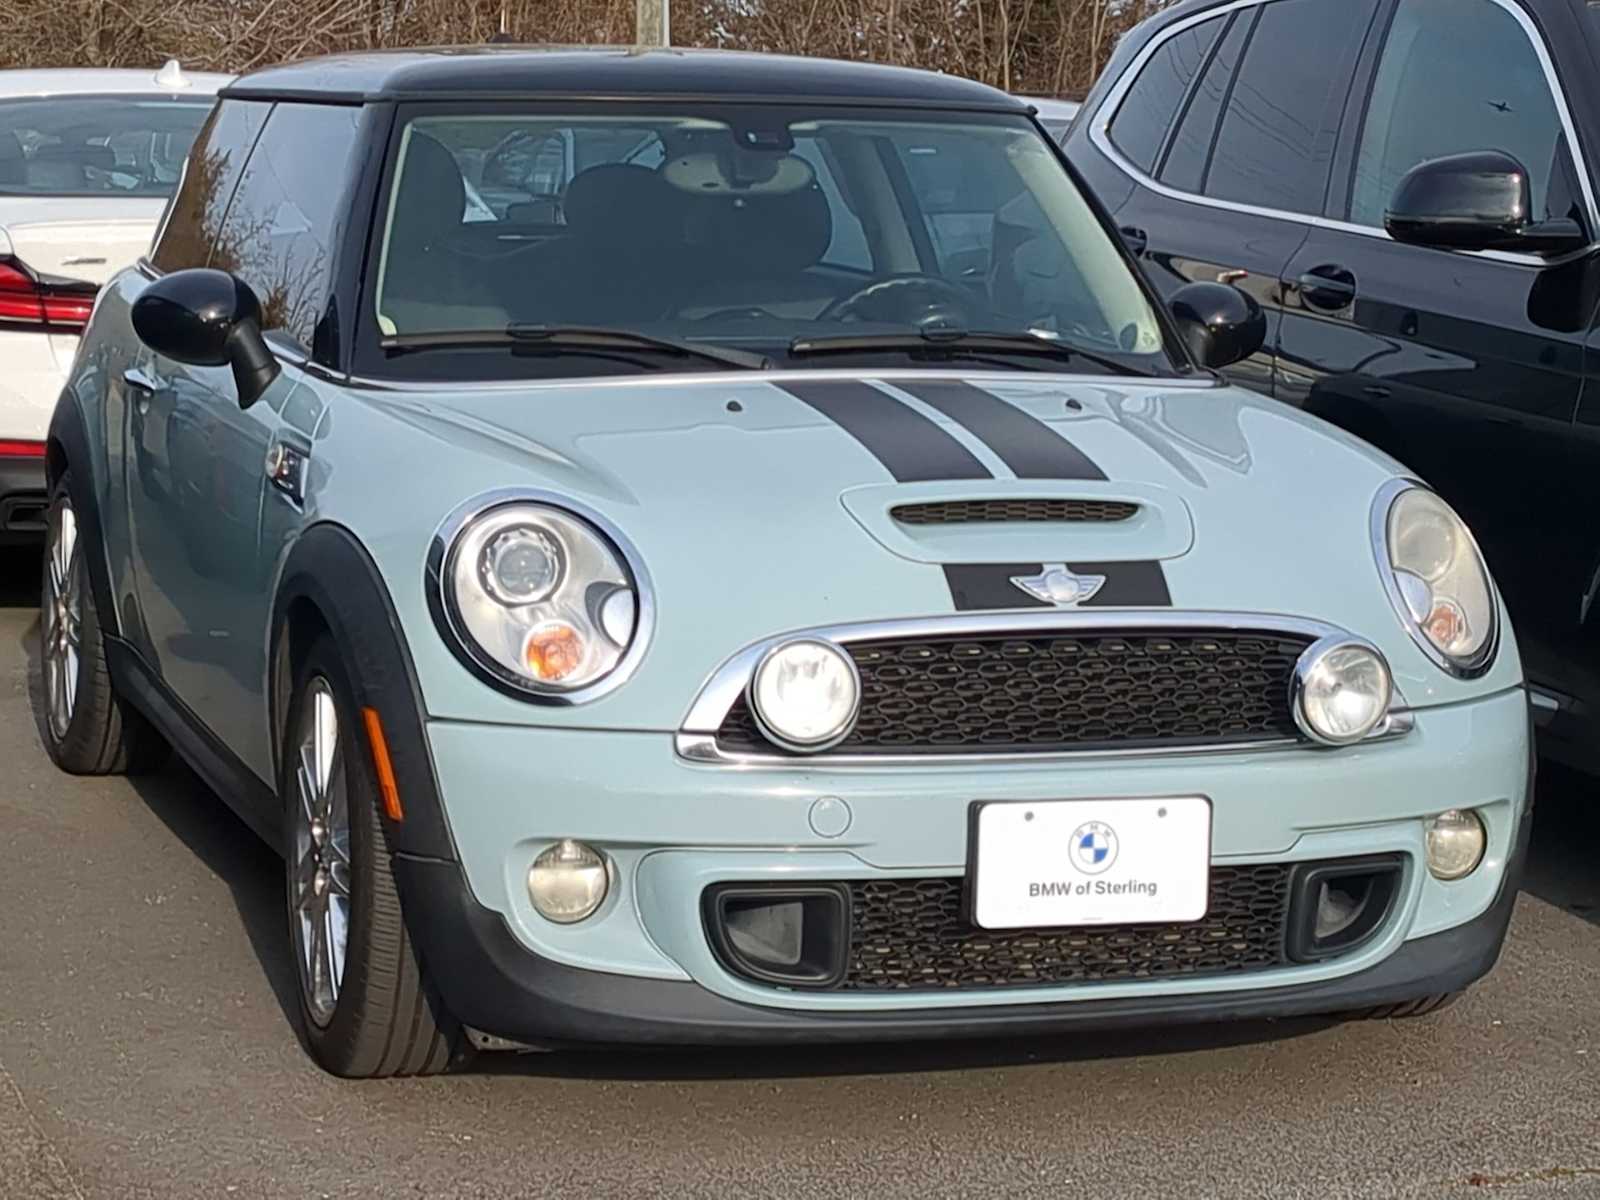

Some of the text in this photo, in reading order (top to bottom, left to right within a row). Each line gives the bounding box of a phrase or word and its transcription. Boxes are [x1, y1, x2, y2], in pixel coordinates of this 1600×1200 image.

[1029, 879, 1157, 897] BMW of Sterling
